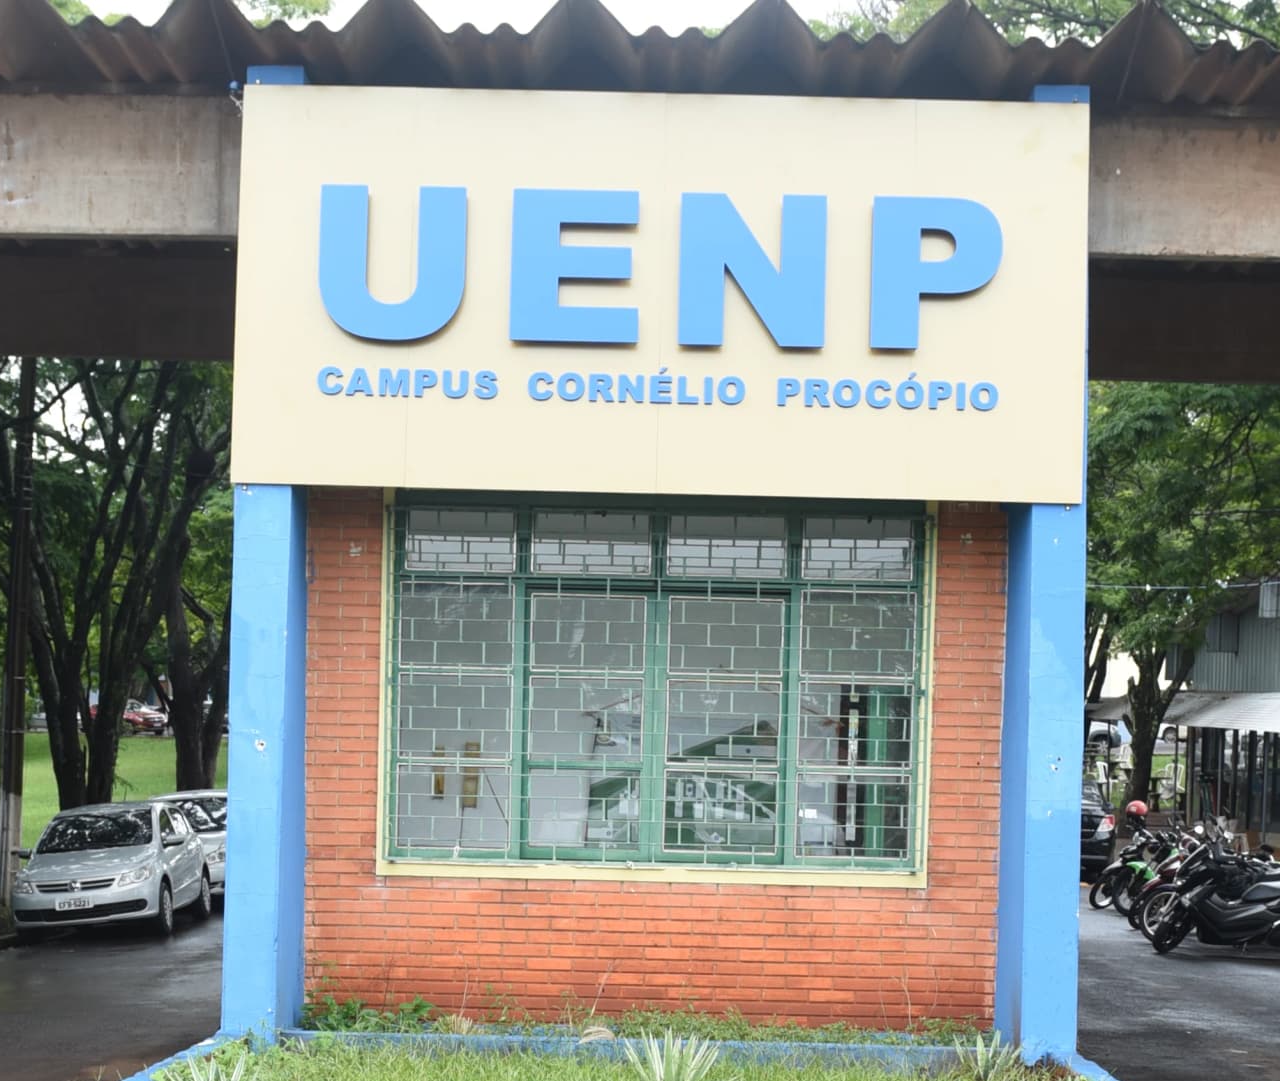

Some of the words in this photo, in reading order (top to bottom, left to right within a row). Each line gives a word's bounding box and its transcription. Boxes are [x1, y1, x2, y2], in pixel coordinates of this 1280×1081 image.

[318, 184, 1003, 350] UENP
[317, 366, 498, 399] CAMPUS
[527, 367, 745, 405] CORNÉLIO
[776, 372, 998, 411] PROCÓPIO
